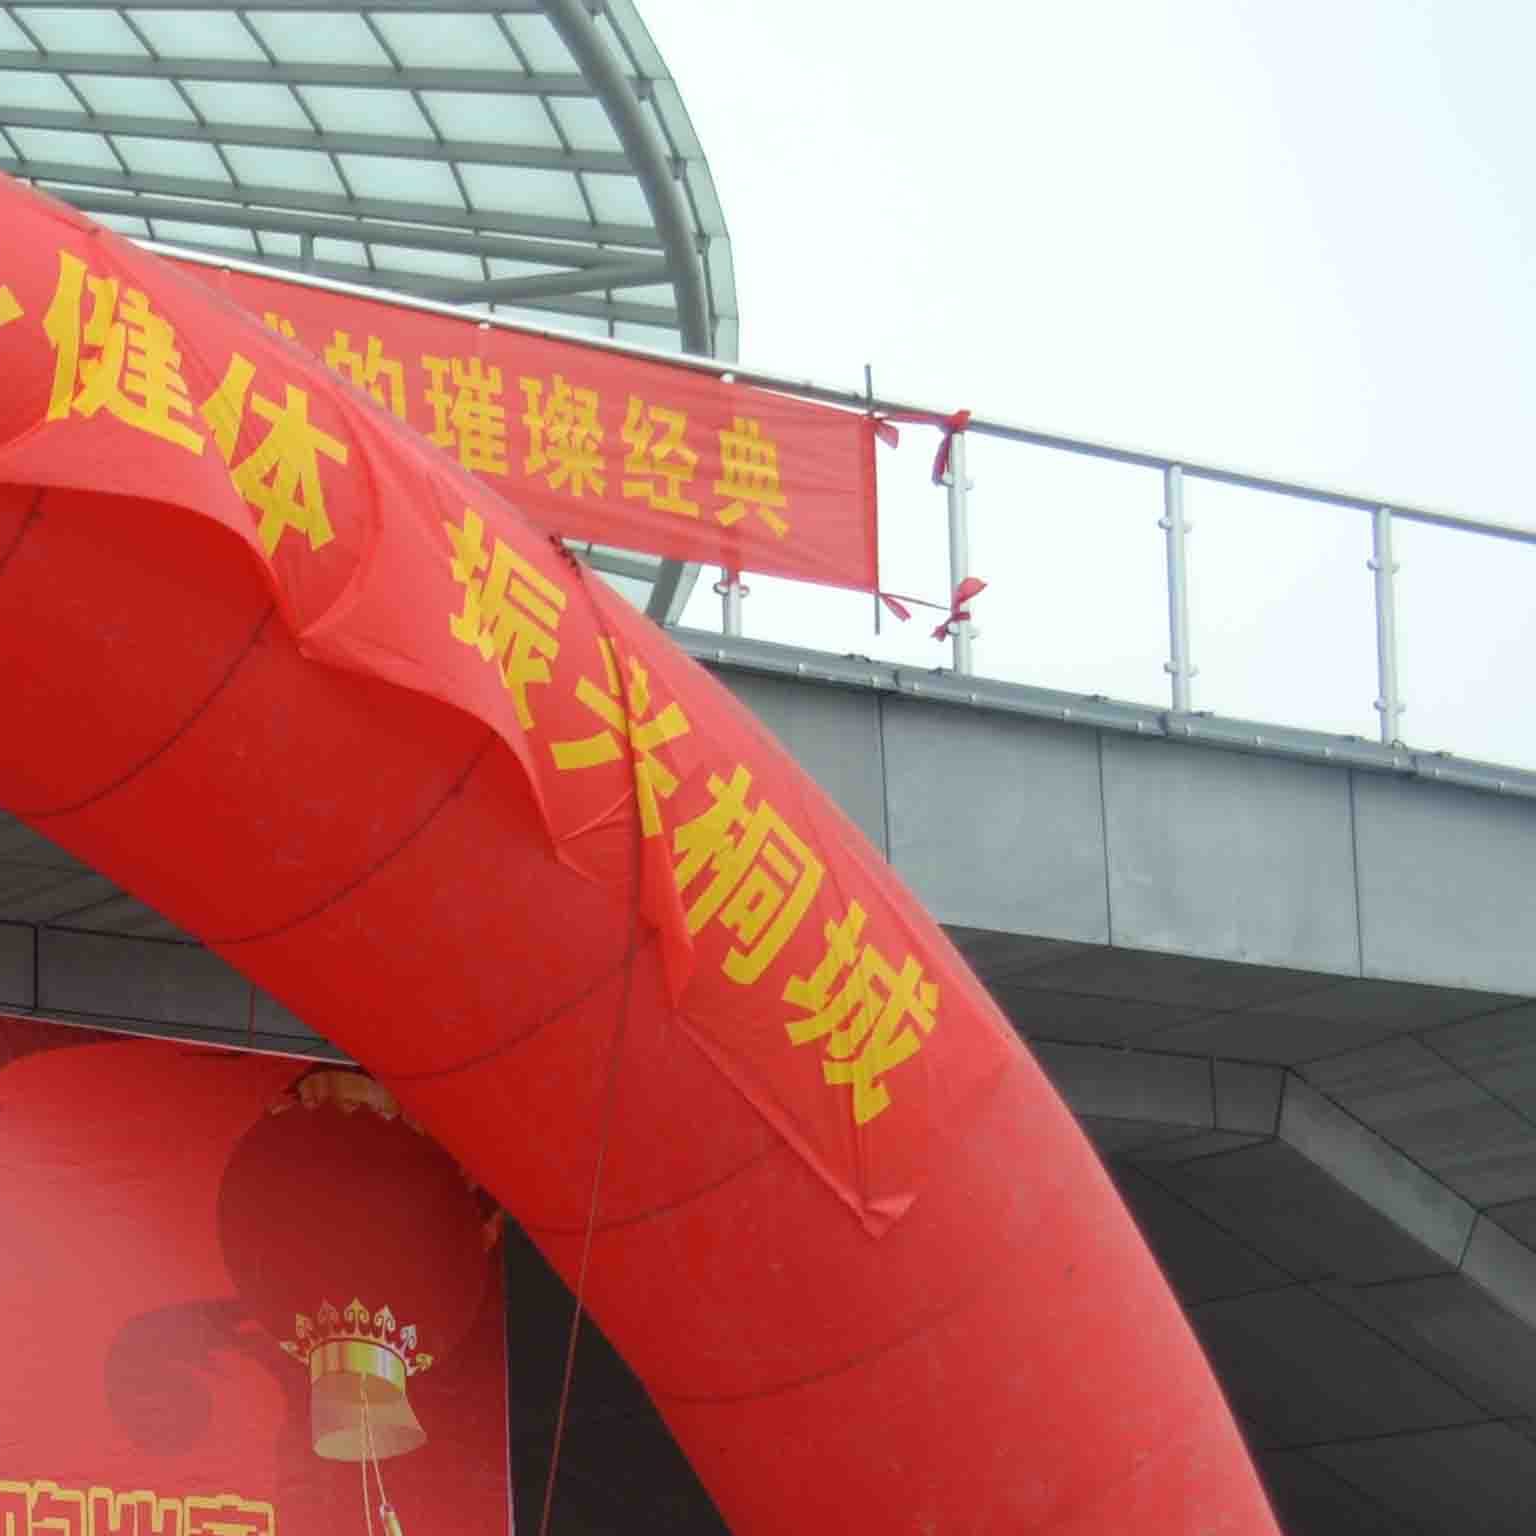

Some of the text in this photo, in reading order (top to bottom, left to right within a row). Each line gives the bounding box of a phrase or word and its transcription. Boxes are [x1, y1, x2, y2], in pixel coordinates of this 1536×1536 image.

[262, 311, 790, 539] 的璀璨经典
[441, 507, 940, 1126] 振兴桐城
